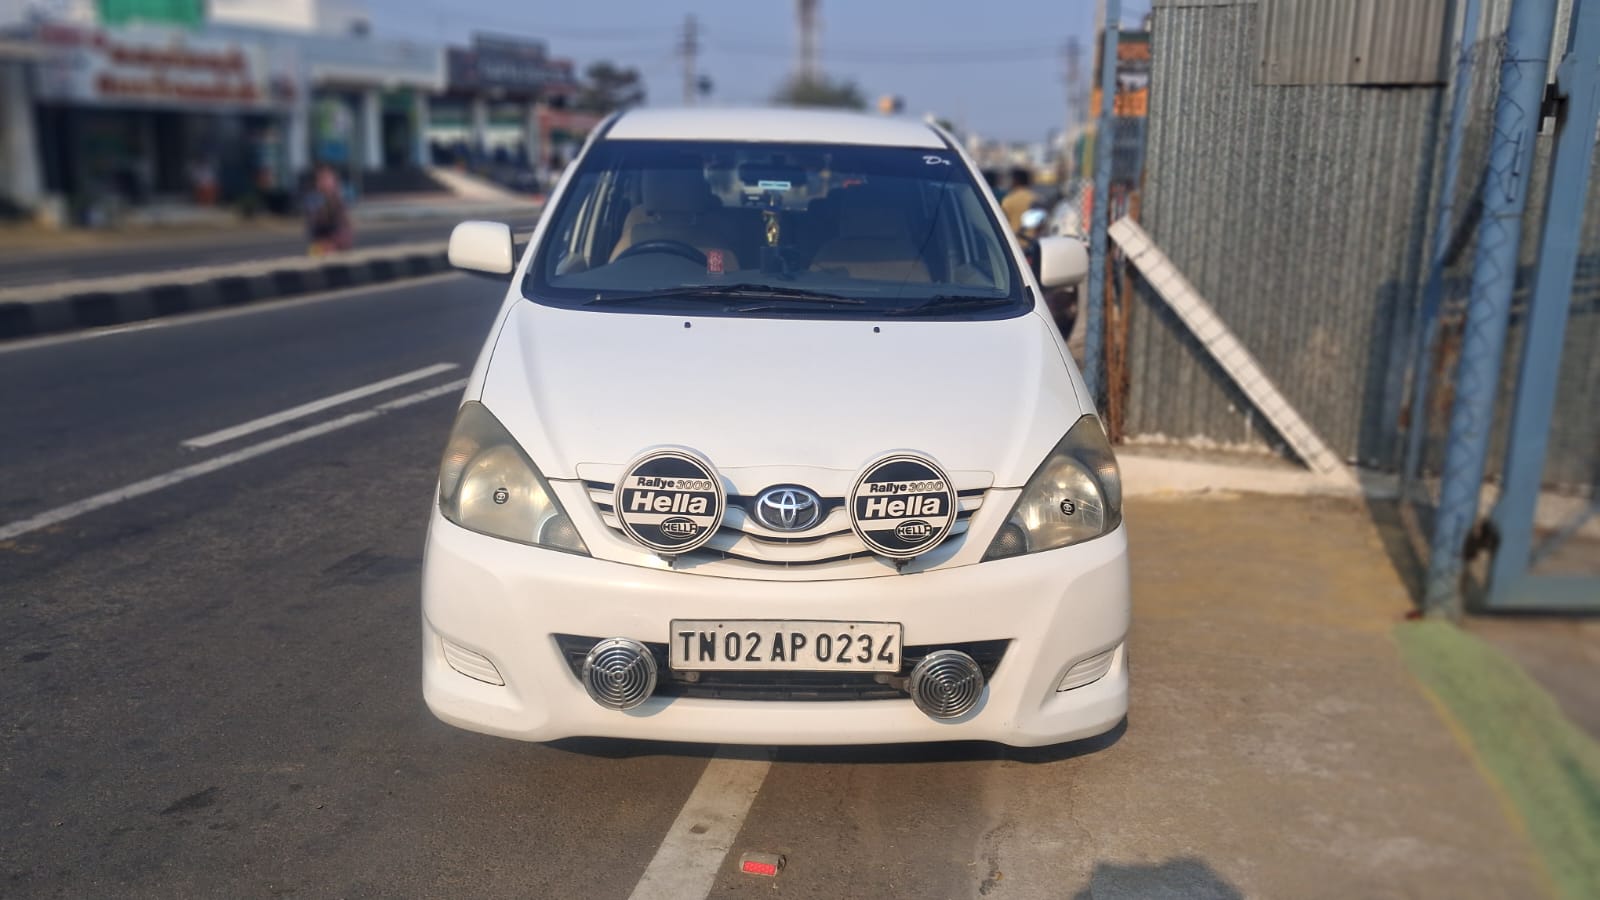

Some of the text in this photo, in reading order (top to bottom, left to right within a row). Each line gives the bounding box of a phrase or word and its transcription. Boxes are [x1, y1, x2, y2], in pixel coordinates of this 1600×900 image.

[637, 477, 712, 491] Rallye 3000
[869, 481, 944, 494] Rallye 3000
[630, 490, 708, 514] Hella
[864, 495, 941, 518] Hella
[663, 522, 699, 534] HELLA
[898, 525, 933, 536] HELLA
[678, 631, 895, 664] TN 02 AP 0234
